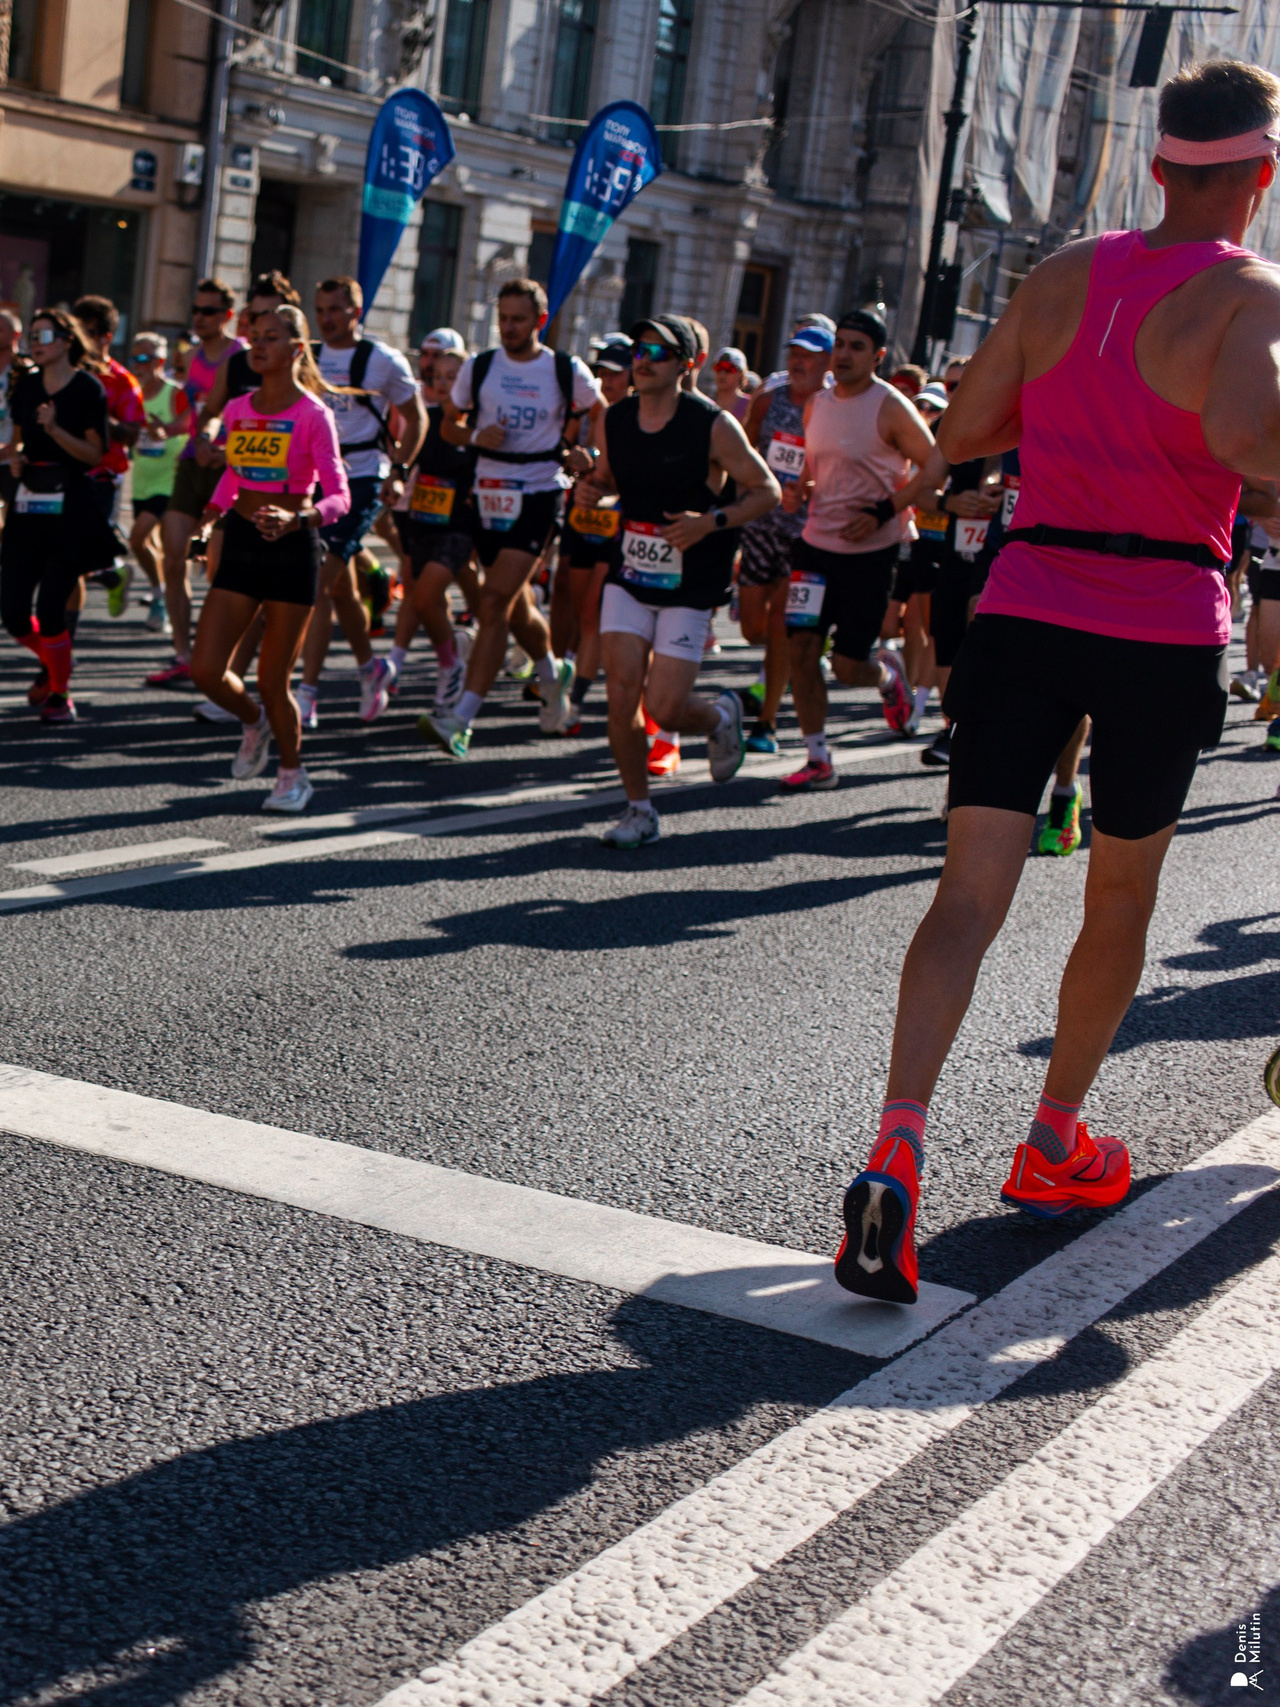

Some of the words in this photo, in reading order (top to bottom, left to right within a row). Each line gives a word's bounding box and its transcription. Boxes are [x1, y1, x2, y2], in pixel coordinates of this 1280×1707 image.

[585, 158, 632, 206] 1:39
[235, 436, 282, 456] 2445
[627, 537, 673, 563] 4862
